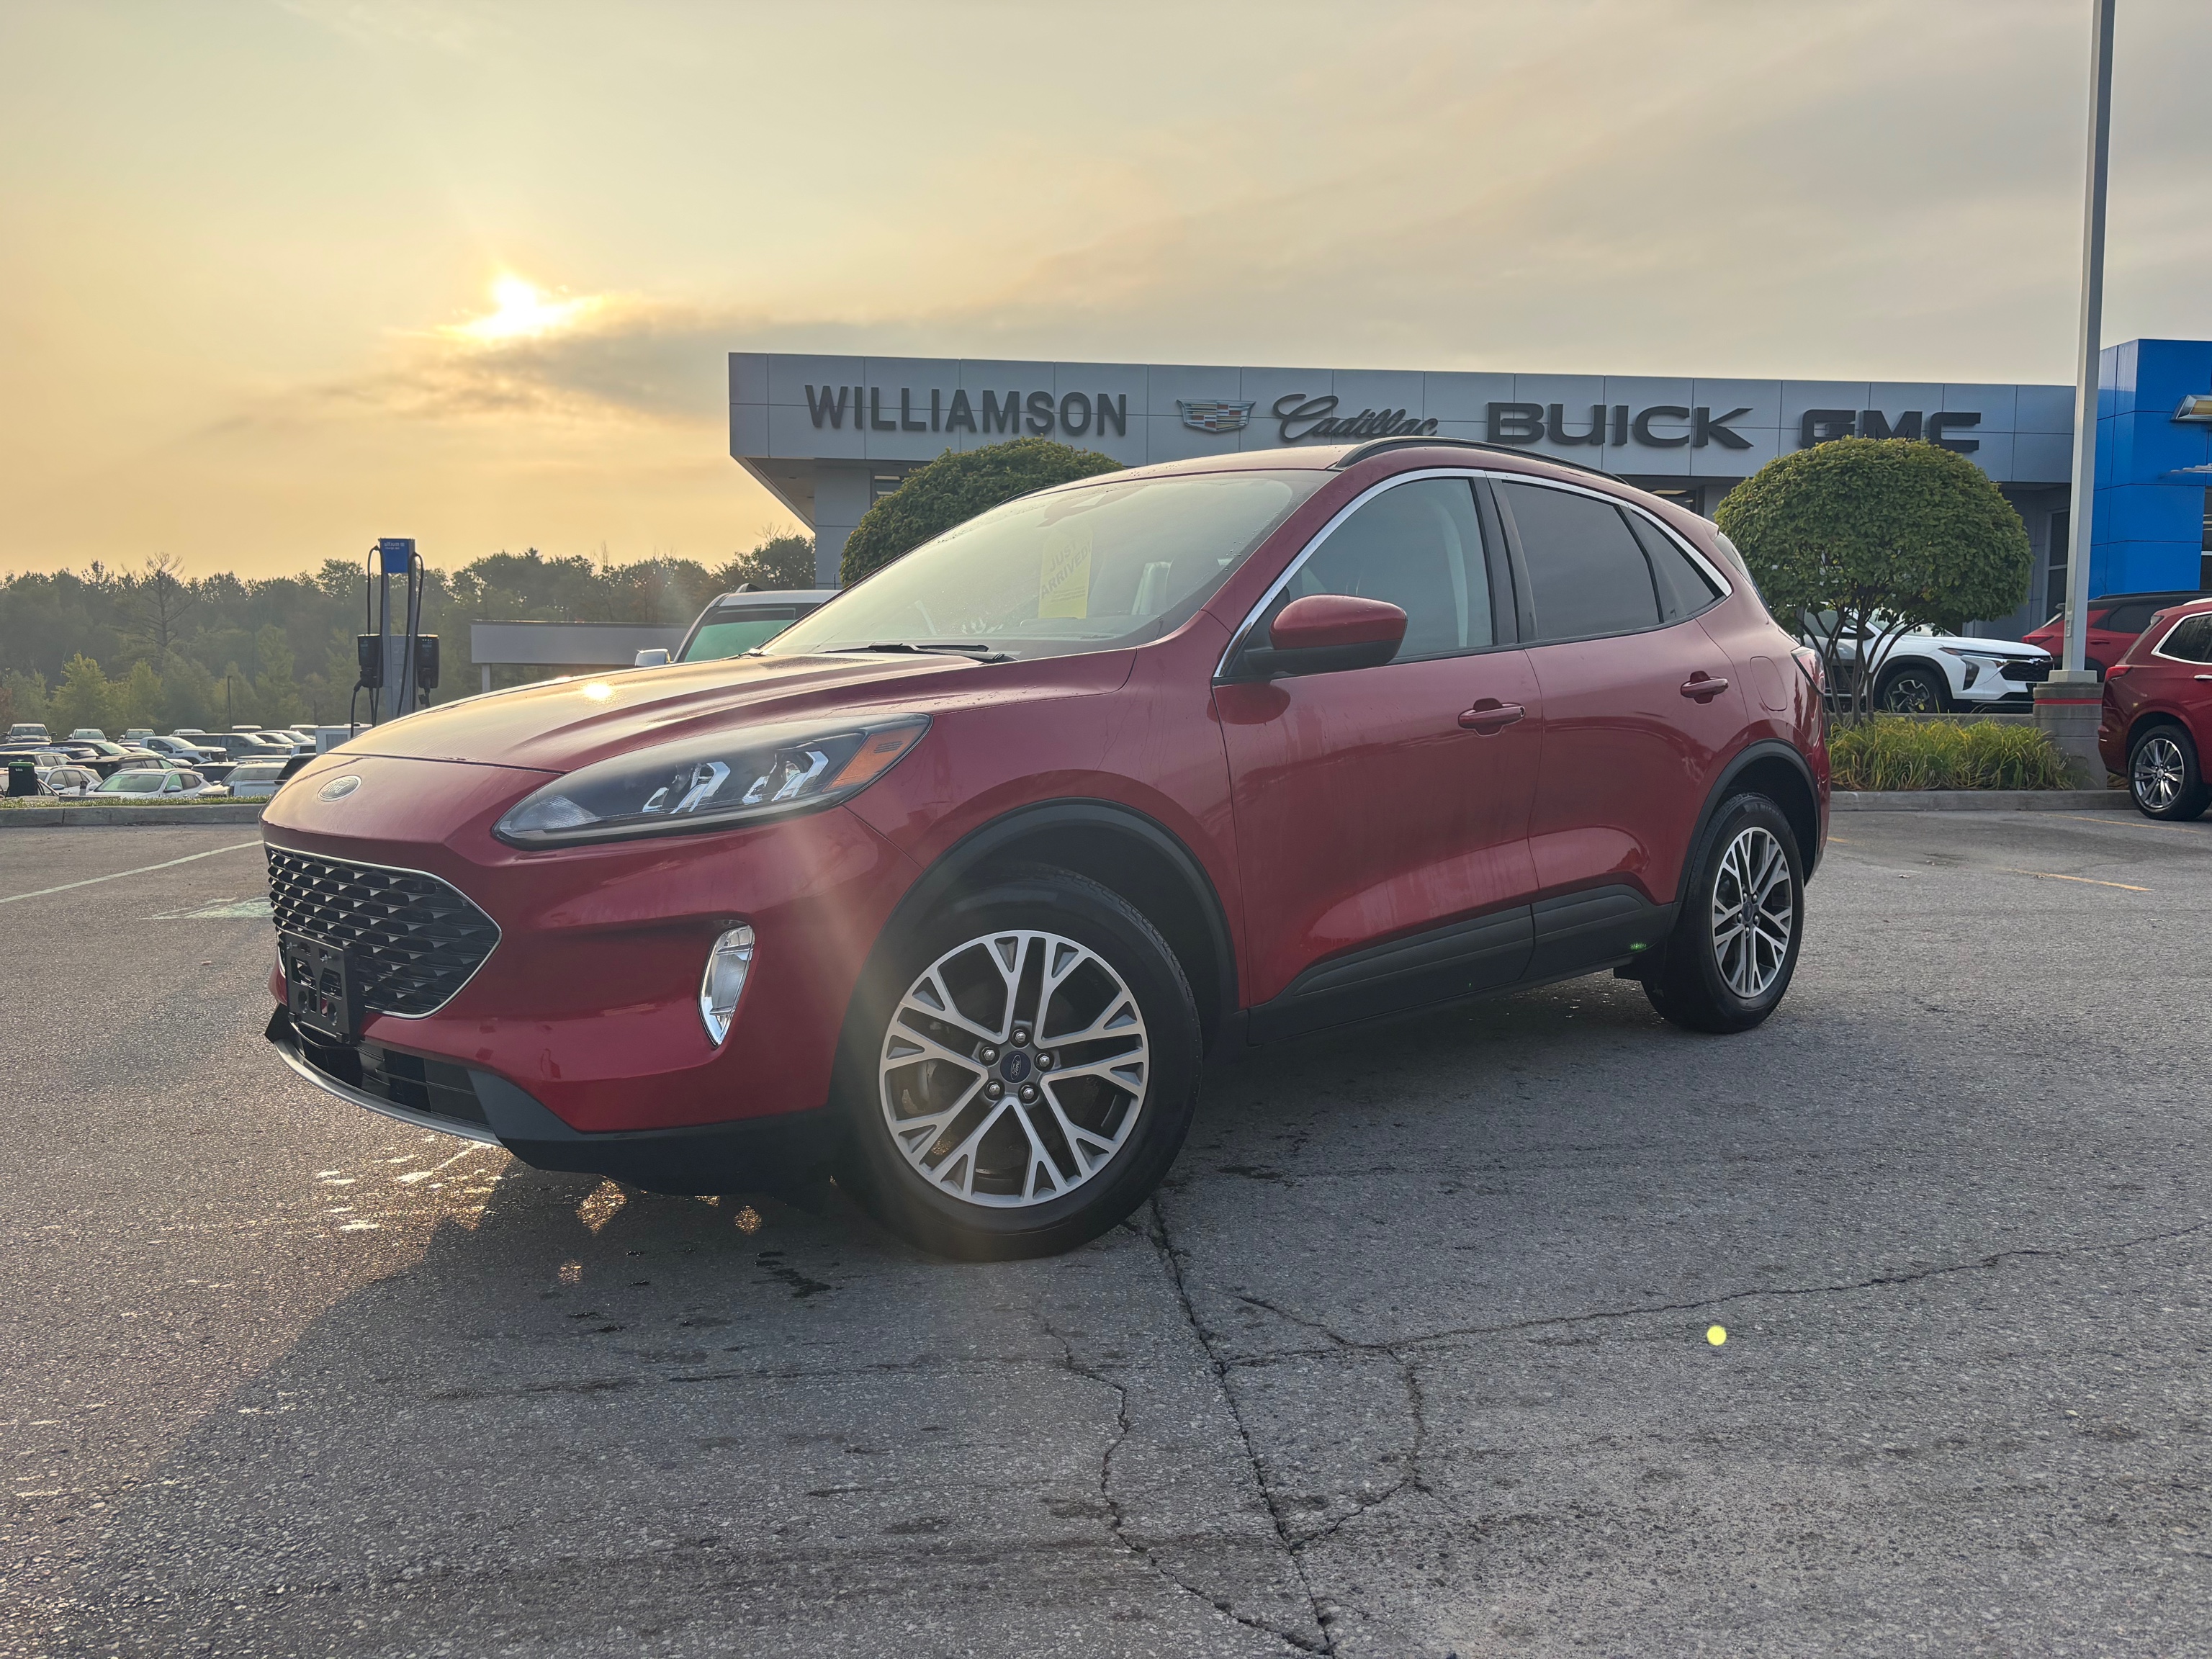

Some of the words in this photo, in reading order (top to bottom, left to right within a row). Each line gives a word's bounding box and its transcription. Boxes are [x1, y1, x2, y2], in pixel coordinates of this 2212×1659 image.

[805, 385, 1126, 436] WILLIAMSON
[1272, 392, 1439, 444] Cadillac
[1485, 401, 1755, 449] BUICK
[1800, 408, 1982, 453] GMC
[1012, 1059, 1020, 1076] Ford
